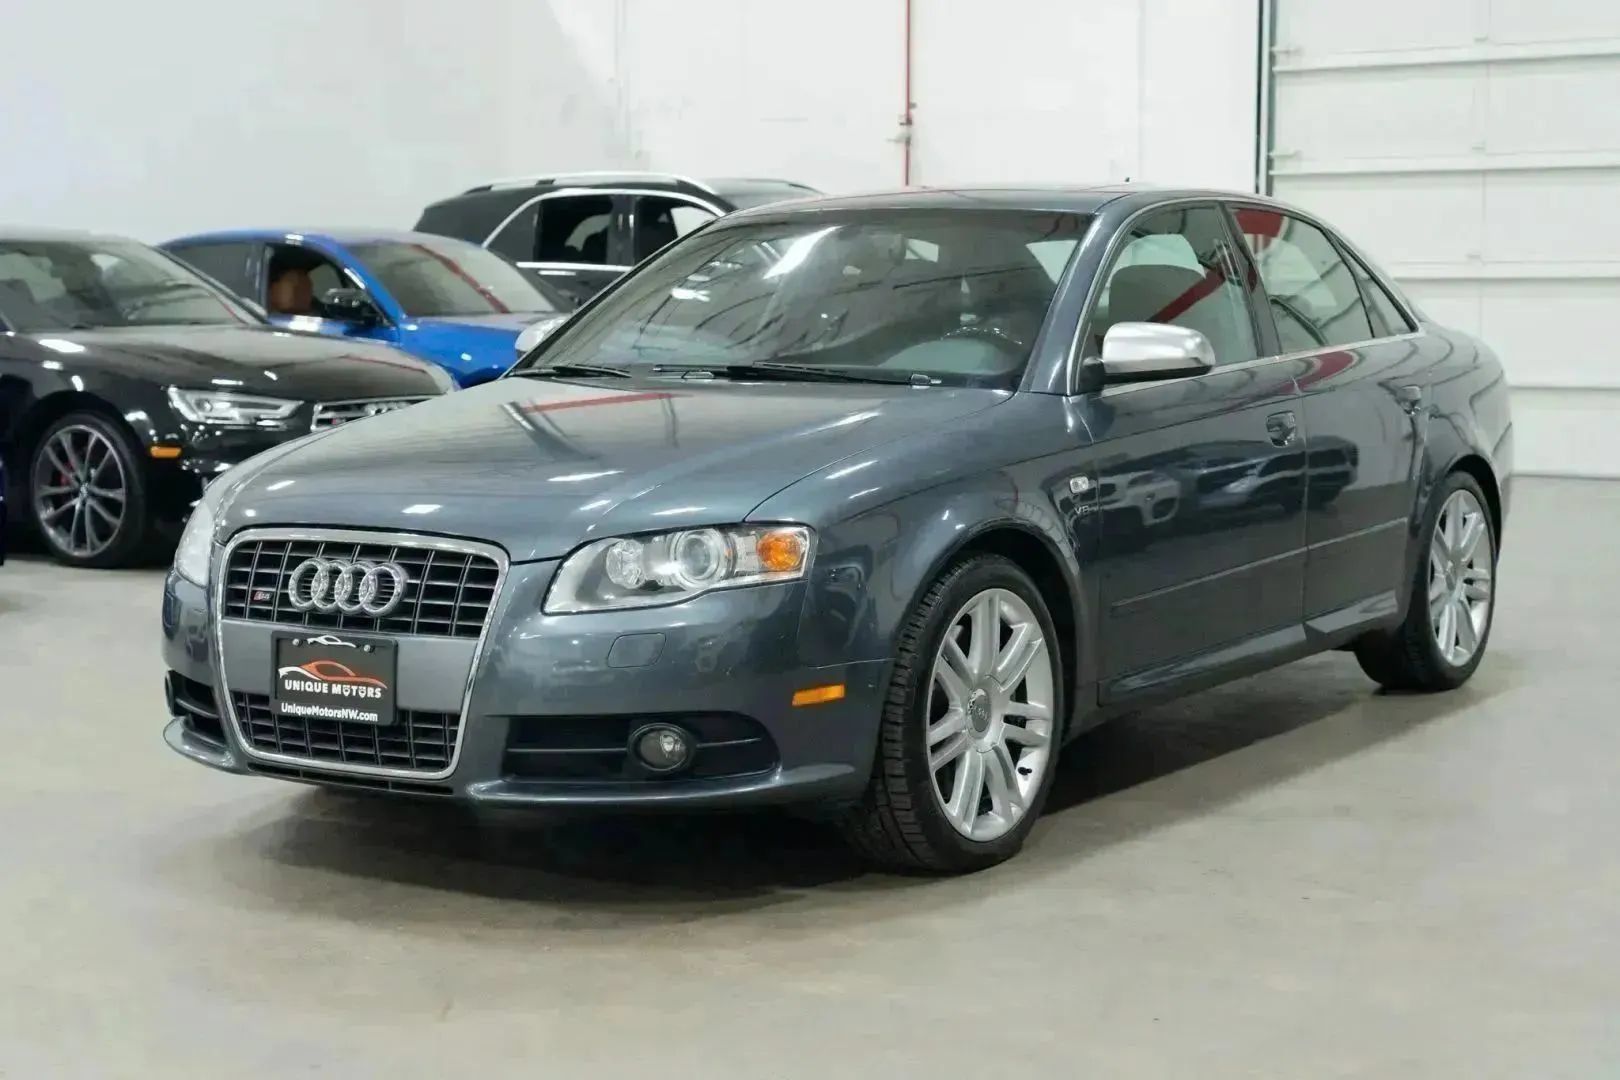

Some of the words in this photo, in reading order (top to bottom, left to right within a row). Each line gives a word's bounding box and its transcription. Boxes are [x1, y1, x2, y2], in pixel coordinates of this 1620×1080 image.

[284, 679, 329, 694] UNIQUE
[331, 683, 382, 699] MOTORS
[281, 702, 378, 722] UniqueMotorsNW.com
